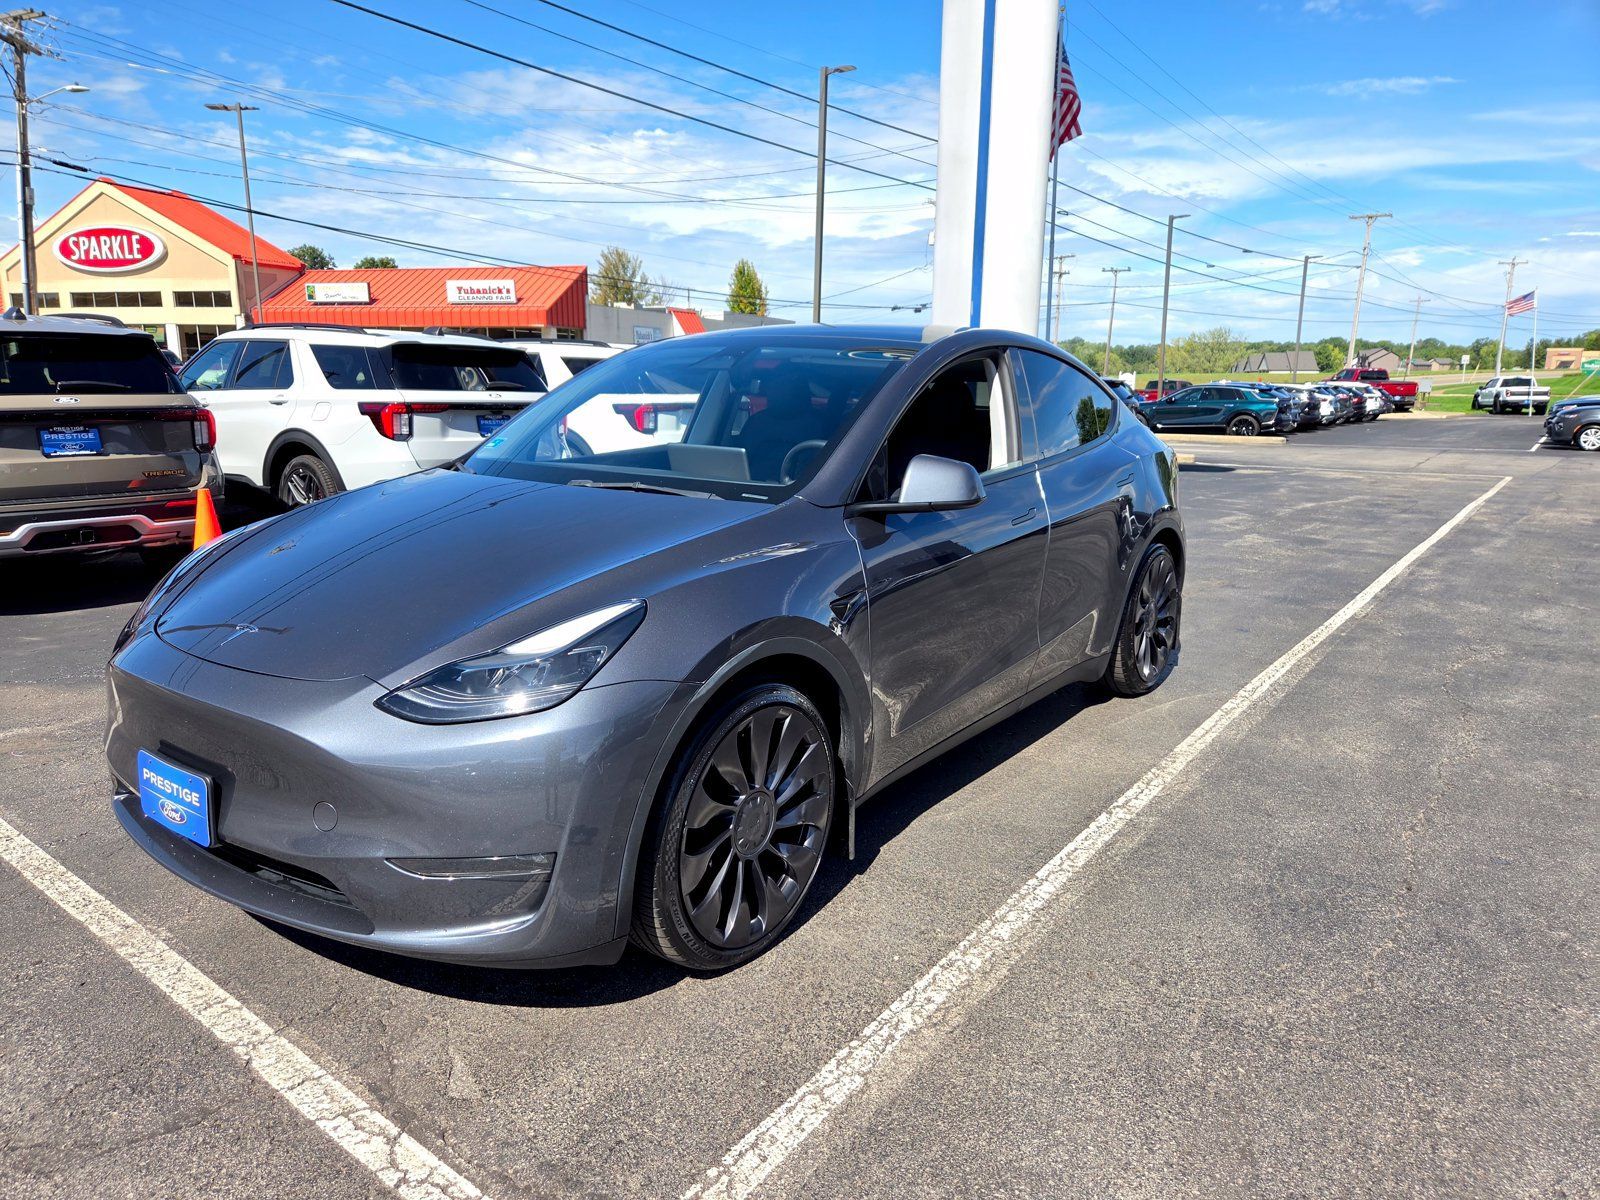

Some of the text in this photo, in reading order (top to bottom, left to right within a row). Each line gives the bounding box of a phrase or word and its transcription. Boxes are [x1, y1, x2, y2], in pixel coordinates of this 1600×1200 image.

[69, 235, 142, 260] SPARKLE
[456, 286, 511, 295] Yuhanick's
[143, 469, 184, 477] TREMOR
[142, 767, 200, 807] PRESTIGE
[163, 801, 181, 821] Ford
